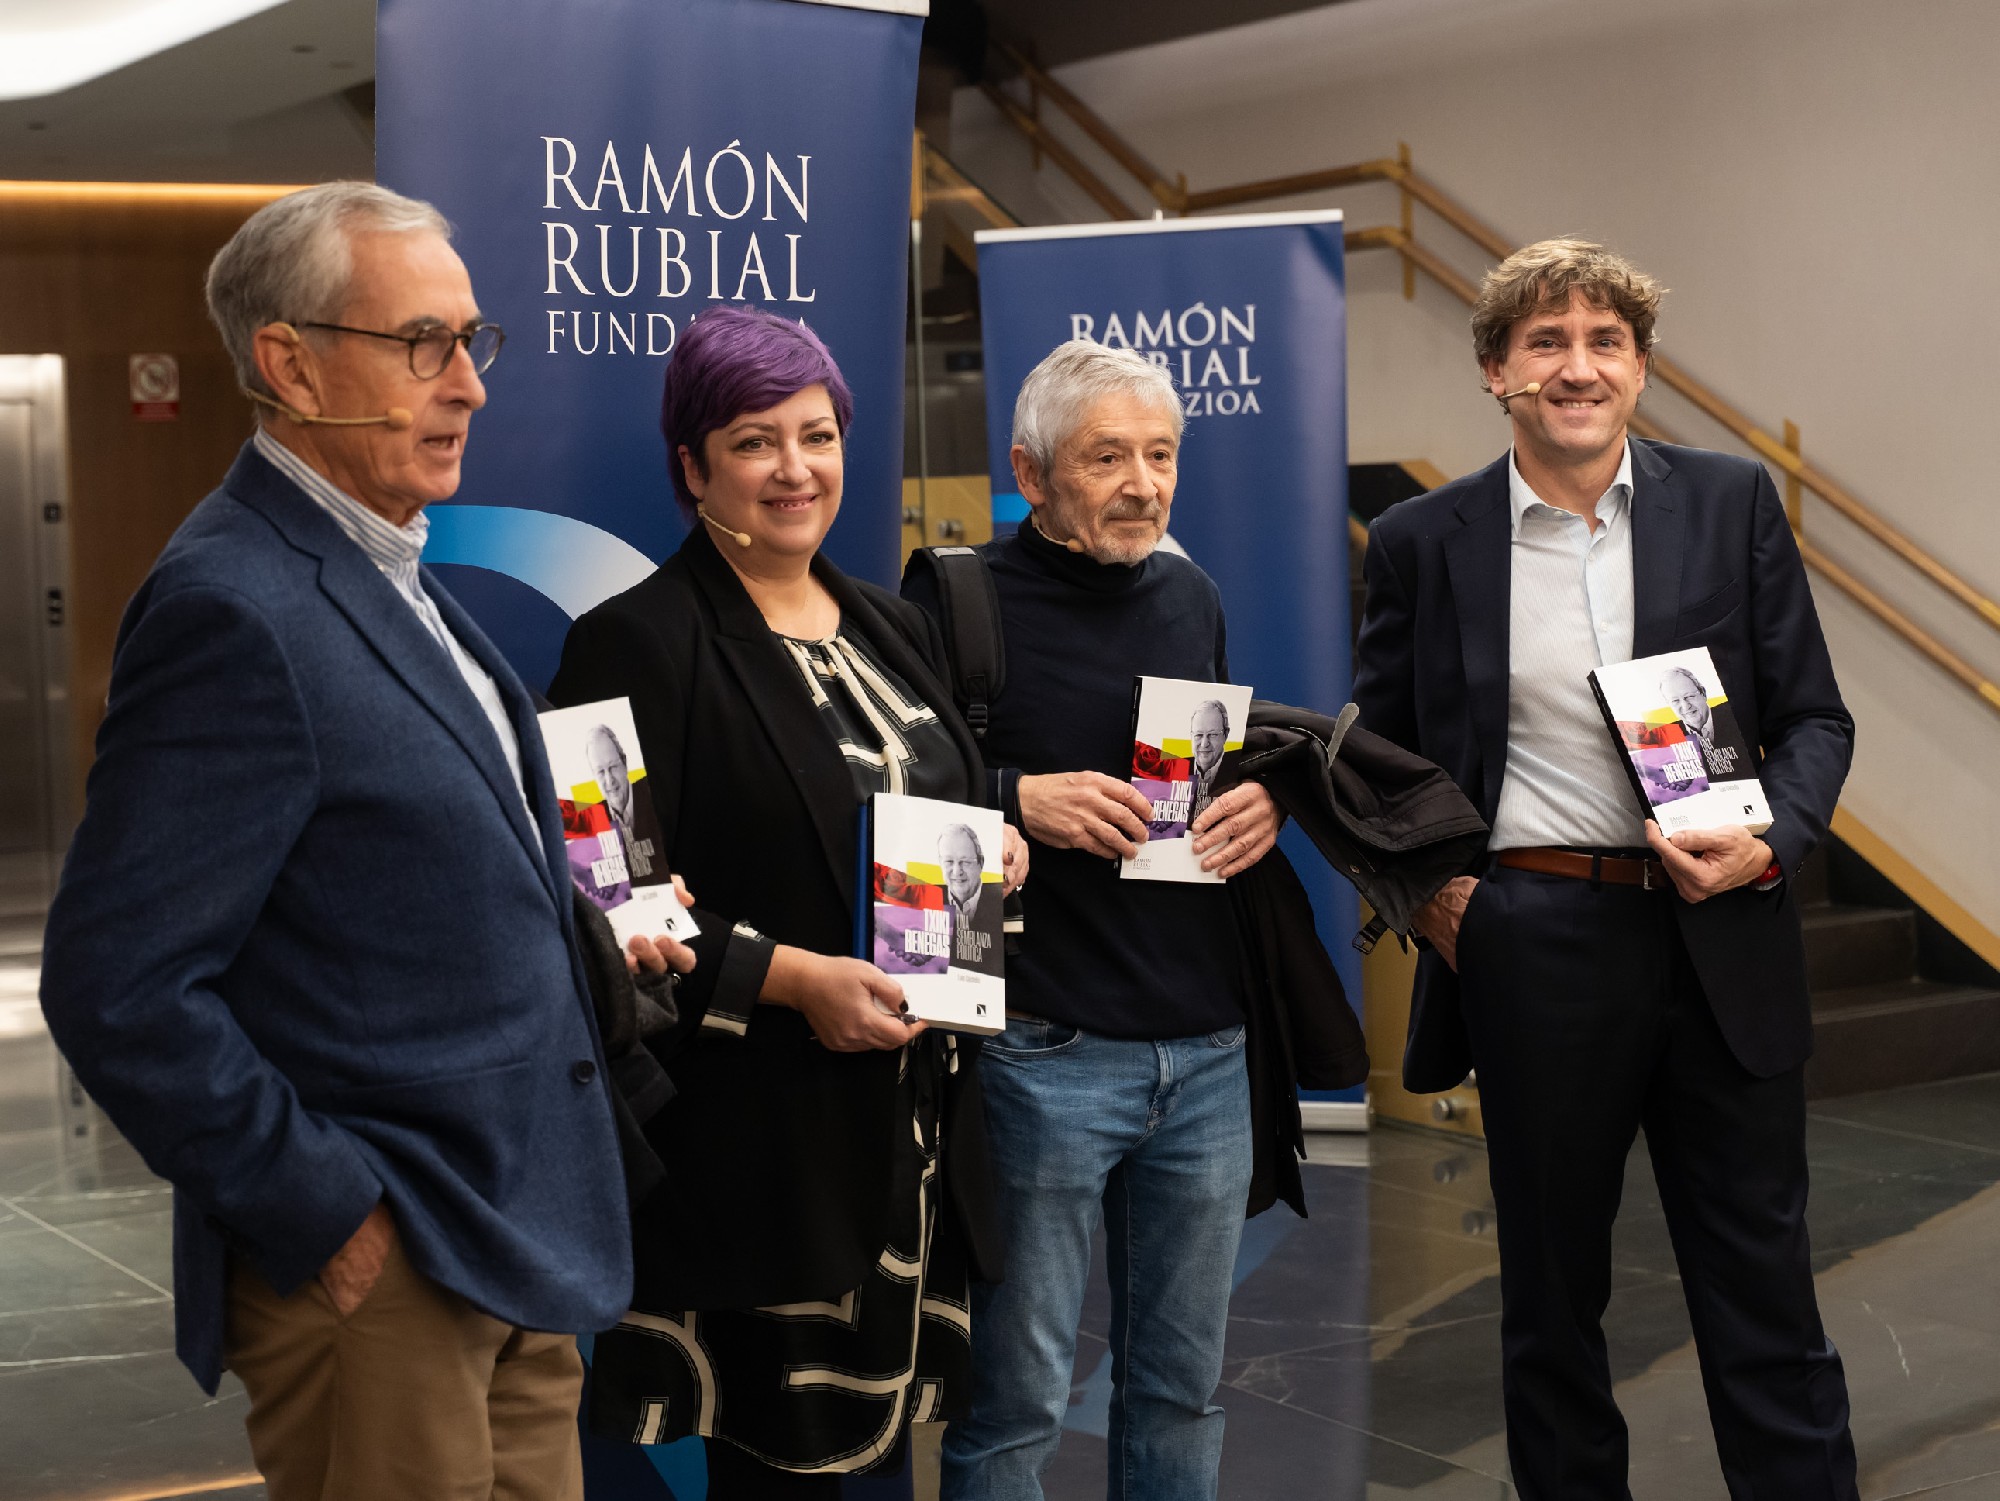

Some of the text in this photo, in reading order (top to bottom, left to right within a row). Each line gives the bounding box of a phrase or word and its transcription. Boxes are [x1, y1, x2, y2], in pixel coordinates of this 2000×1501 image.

[540, 136, 812, 223] RAMÓN
[541, 222, 816, 302] RUBIAL
[1069, 301, 1256, 348] RAMÓN
[1147, 346, 1262, 388] BIAL
[1153, 800, 1190, 822] BENEGAS
[923, 908, 950, 936] TXIKI
[956, 913, 970, 931] UNA
[905, 928, 951, 959] BENEGAS
